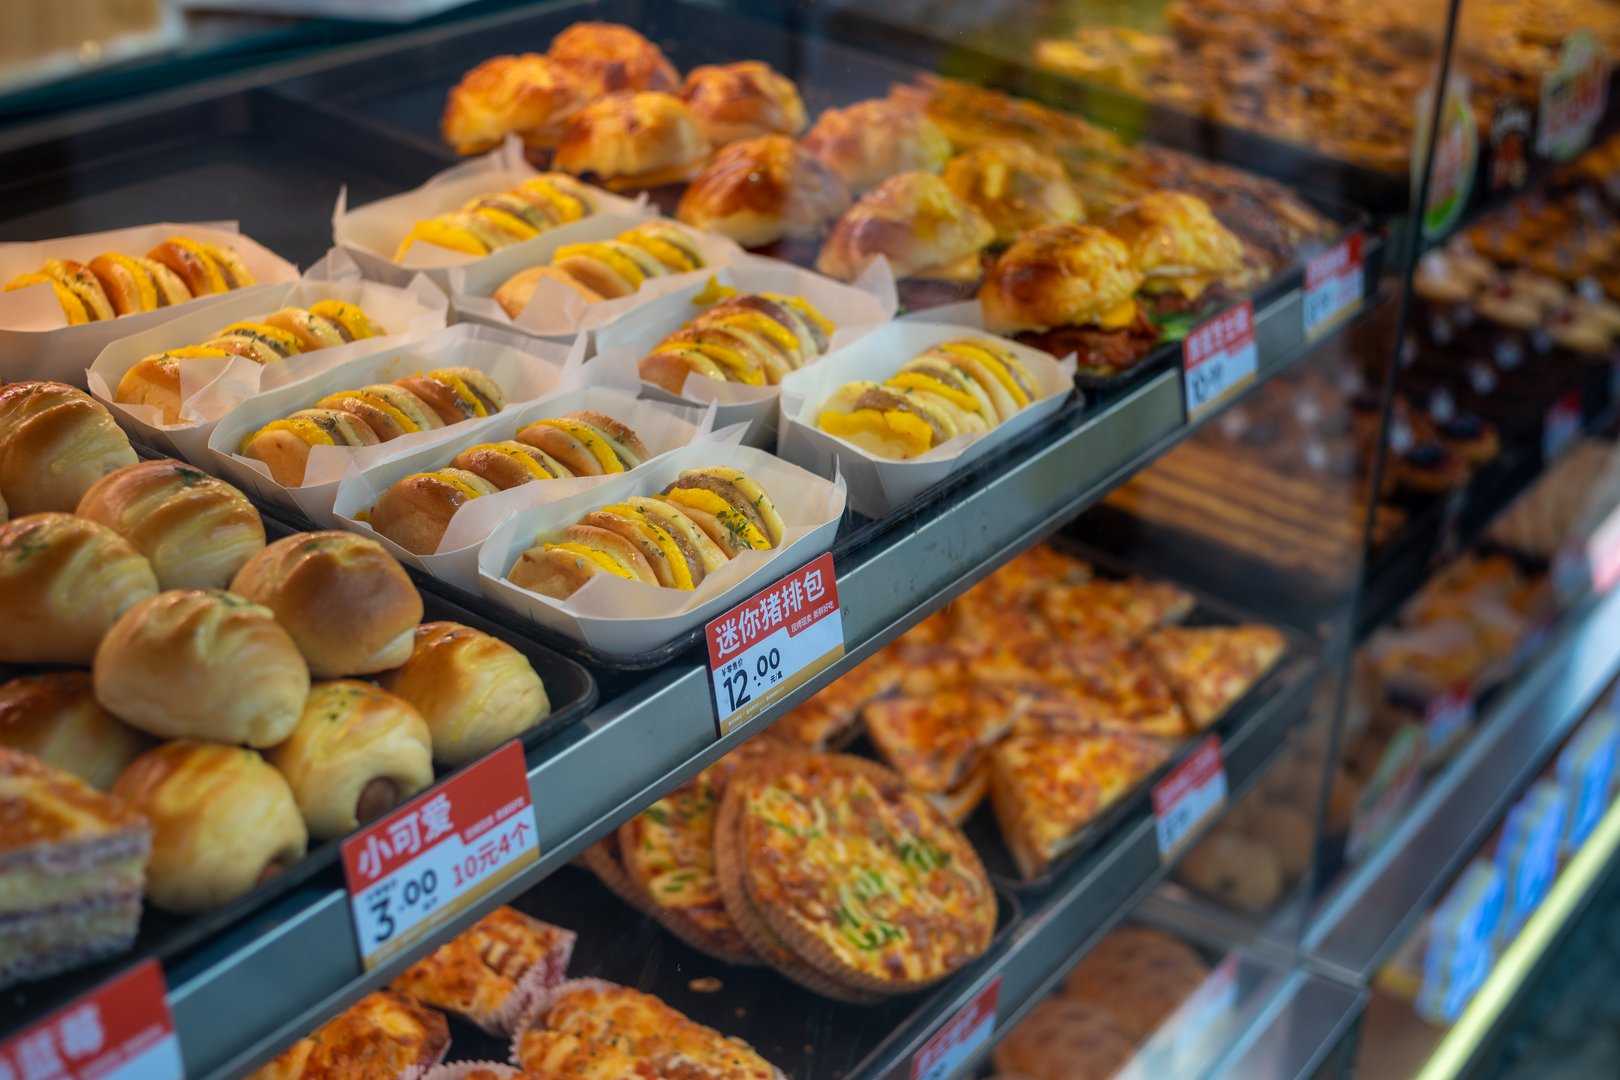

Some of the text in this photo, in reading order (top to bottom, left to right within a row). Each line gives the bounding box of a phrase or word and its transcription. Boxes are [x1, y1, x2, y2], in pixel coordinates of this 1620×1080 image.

[715, 568, 825, 659] 迷你猪排包
[358, 792, 454, 879] 小可爱
[451, 821, 530, 888] 10元4个
[369, 867, 438, 944] 3.00
